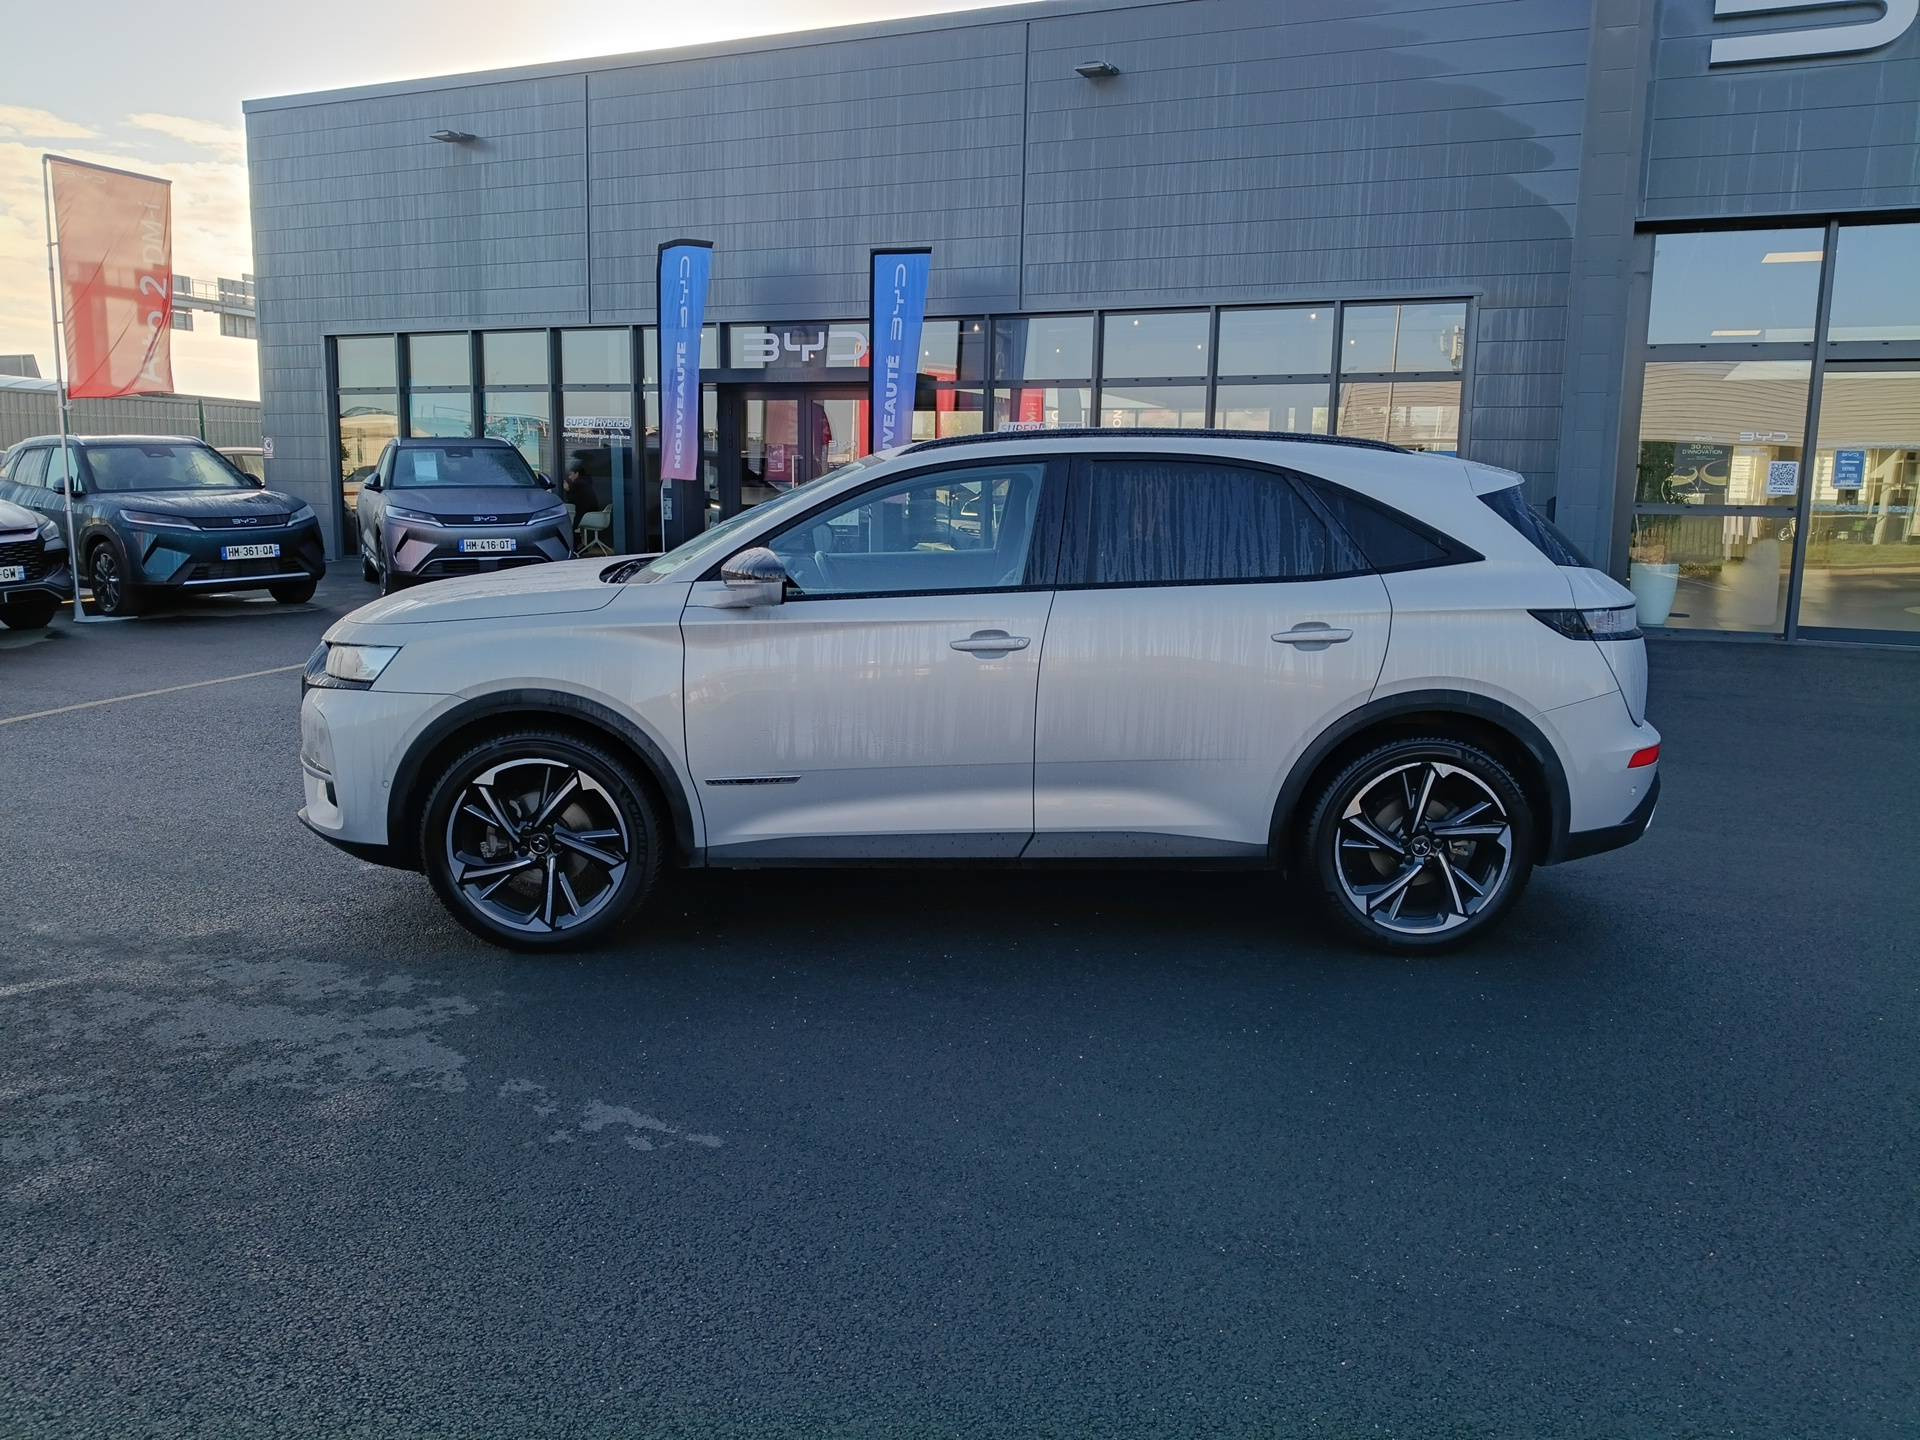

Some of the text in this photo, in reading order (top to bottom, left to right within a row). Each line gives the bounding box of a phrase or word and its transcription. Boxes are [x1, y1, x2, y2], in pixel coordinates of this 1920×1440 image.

[139, 275, 167, 299] 2
[679, 255, 690, 329] BYD
[891, 263, 906, 341] BYD
[743, 331, 868, 362] BYD
[566, 417, 629, 428] SUPER Hybride
[1739, 431, 1788, 442] BYD
